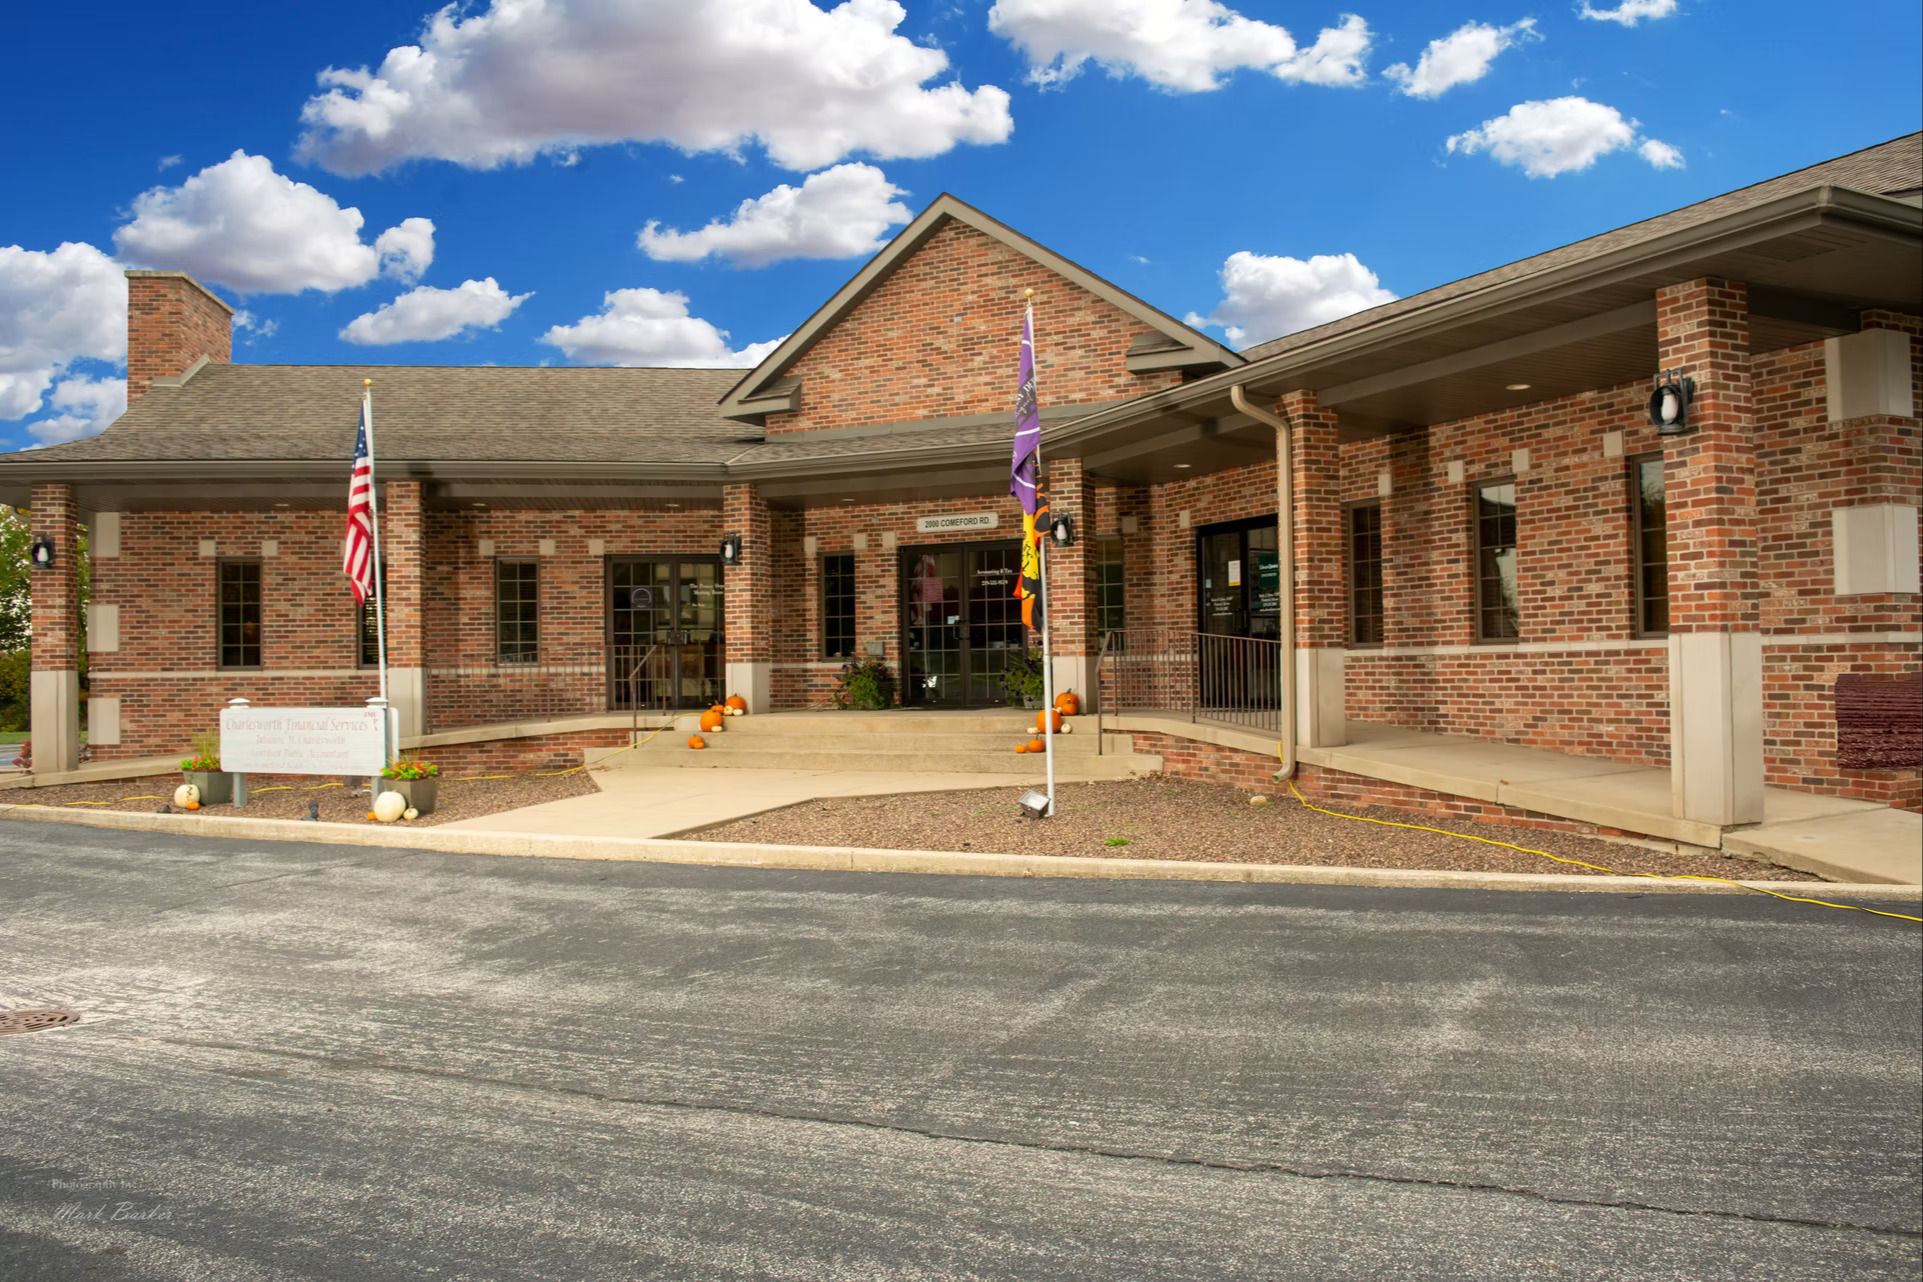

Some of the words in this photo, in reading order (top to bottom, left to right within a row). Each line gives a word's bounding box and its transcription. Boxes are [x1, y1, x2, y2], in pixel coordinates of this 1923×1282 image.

[924, 520, 940, 528] 2000
[940, 518, 978, 528] COMEFORD
[226, 718, 283, 731] Charlesworth
[285, 718, 329, 734] Financial
[329, 718, 369, 731] Services
